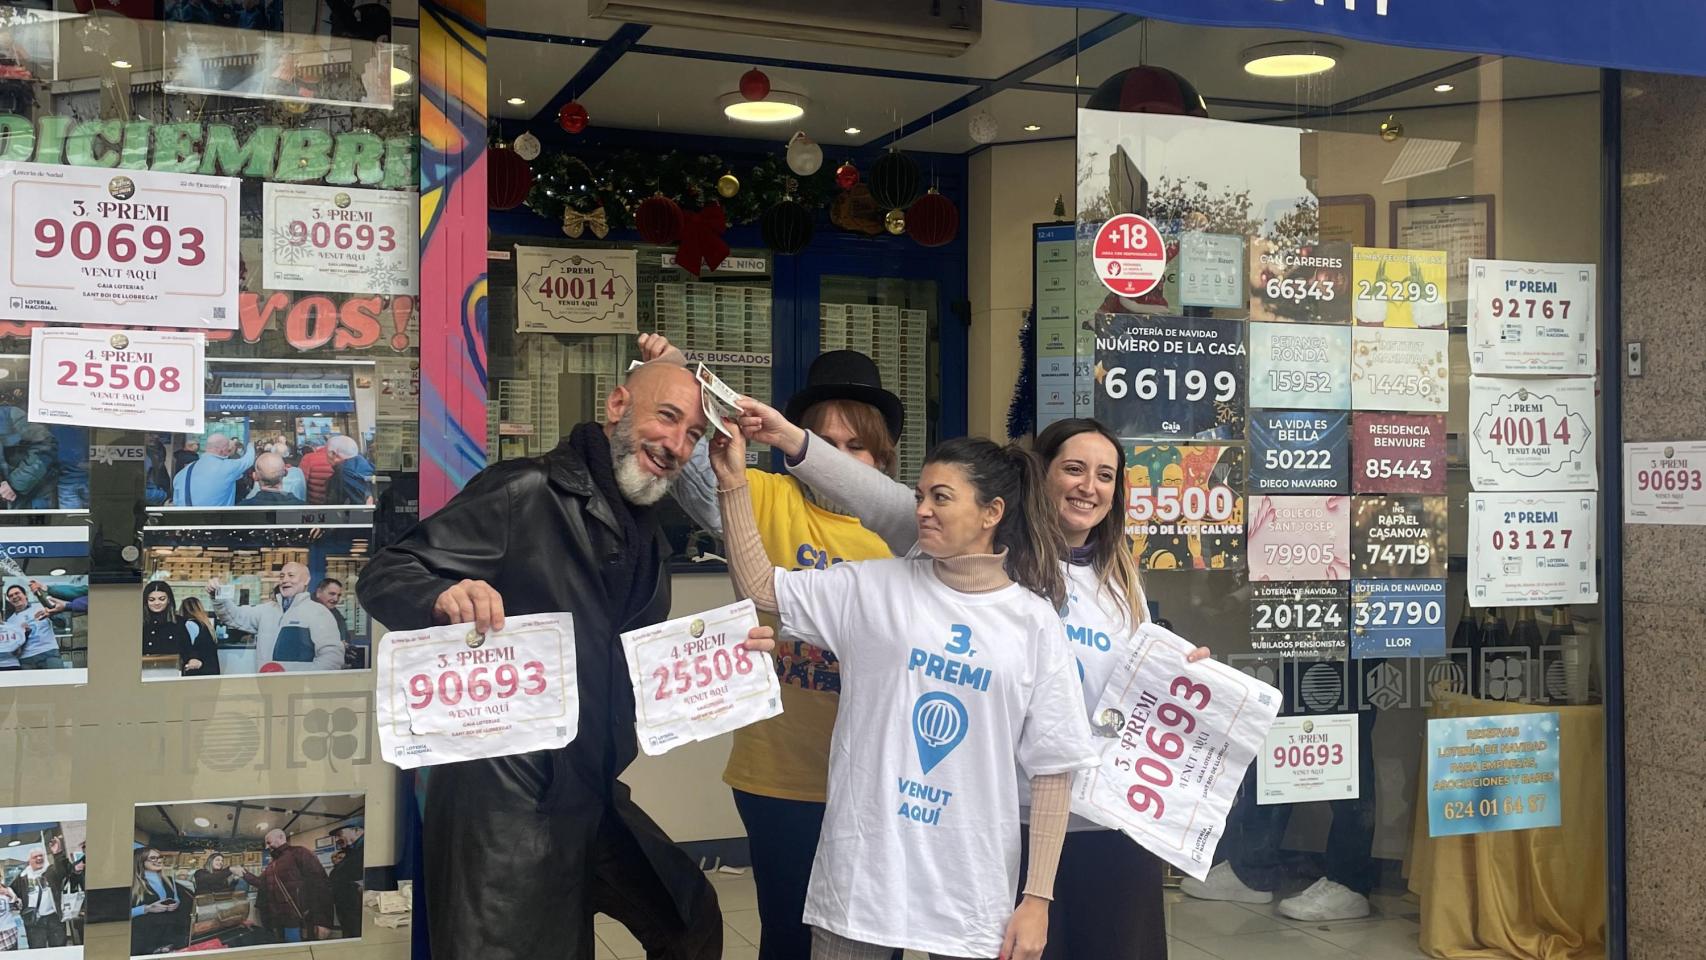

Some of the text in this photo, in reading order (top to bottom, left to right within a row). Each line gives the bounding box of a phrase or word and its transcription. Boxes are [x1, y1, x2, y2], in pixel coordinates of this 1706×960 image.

[97, 201, 169, 222] PREMI
[328, 209, 373, 223] PREMI
[34, 218, 206, 266] 90693
[288, 220, 396, 252] 90693
[1108, 223, 1148, 250] +18
[318, 252, 343, 260] VENUT
[1286, 256, 1343, 269] CARRERES
[81, 266, 157, 281] VENUT AQUÍ
[539, 276, 616, 300] 40014
[1266, 278, 1335, 301] 66343
[1358, 280, 1438, 302] 22299
[1520, 280, 1557, 293] PREMI
[1492, 298, 1571, 319] 92767
[238, 292, 414, 352] VOS!
[1127, 326, 1218, 338] LOTERÍA DE NAVIDAD
[1096, 335, 1247, 356] NÚMERO DE LA CASA
[1271, 348, 1329, 363] RONDA
[101, 350, 153, 364] PREMI
[708, 353, 770, 364] BUSCADOS
[57, 360, 181, 393] 25508
[1105, 367, 1237, 402] 66199
[1268, 370, 1332, 393] 15952
[1368, 374, 1431, 396] 14456
[220, 402, 321, 412] www.gaialoterias.com
[1514, 404, 1543, 413] PREMI
[1269, 420, 1327, 430] LA VIDA ES
[1369, 424, 1430, 436] RESIDENCIA
[1490, 416, 1571, 446] 40014
[1278, 430, 1319, 442] BELLA
[1374, 438, 1426, 448] BENVIURE
[1264, 450, 1332, 470] 50222
[1366, 459, 1432, 479] 85443
[1260, 479, 1338, 488] DIEGO NAVARRO
[1638, 470, 1702, 491] 90693
[1378, 514, 1419, 526] RAFAEL
[1392, 506, 1405, 514] INS
[1518, 512, 1559, 523] PREMI
[1160, 524, 1175, 535] DE
[1178, 524, 1199, 535] LOS
[1200, 524, 1243, 535] CALVOS
[1268, 522, 1298, 532] SANT
[1369, 528, 1428, 539] CASANOVA
[1492, 530, 1573, 550] 03127
[1264, 544, 1335, 565] 79905
[1367, 544, 1430, 566] 74719
[1262, 587, 1292, 596] LOTERÍA
[1292, 588, 1304, 596] DE
[1355, 583, 1442, 593] LOTERÍA DE NAVIDAD
[1256, 603, 1342, 629] 20124
[1354, 601, 1441, 626] 32790
[684, 632, 726, 656] PREMI
[1066, 624, 1112, 653] MIO
[1294, 640, 1346, 648] PENSIONISTAS
[1386, 638, 1412, 648] LLOR
[456, 646, 515, 666] PREMI
[652, 642, 753, 701] 25508
[908, 648, 993, 692] PREMI
[409, 660, 547, 710] 90693
[448, 706, 482, 719] VENUT
[1121, 690, 1159, 751] PREMI
[1126, 676, 1212, 820] 90693
[1298, 734, 1328, 744] PREMI
[1274, 744, 1344, 768] 90693
[898, 777, 953, 806] VENUT
[898, 806, 942, 826] AQUÍ
[1444, 800, 1475, 820] 624
[1480, 798, 1499, 817] 01
[1503, 796, 1523, 815] 64
